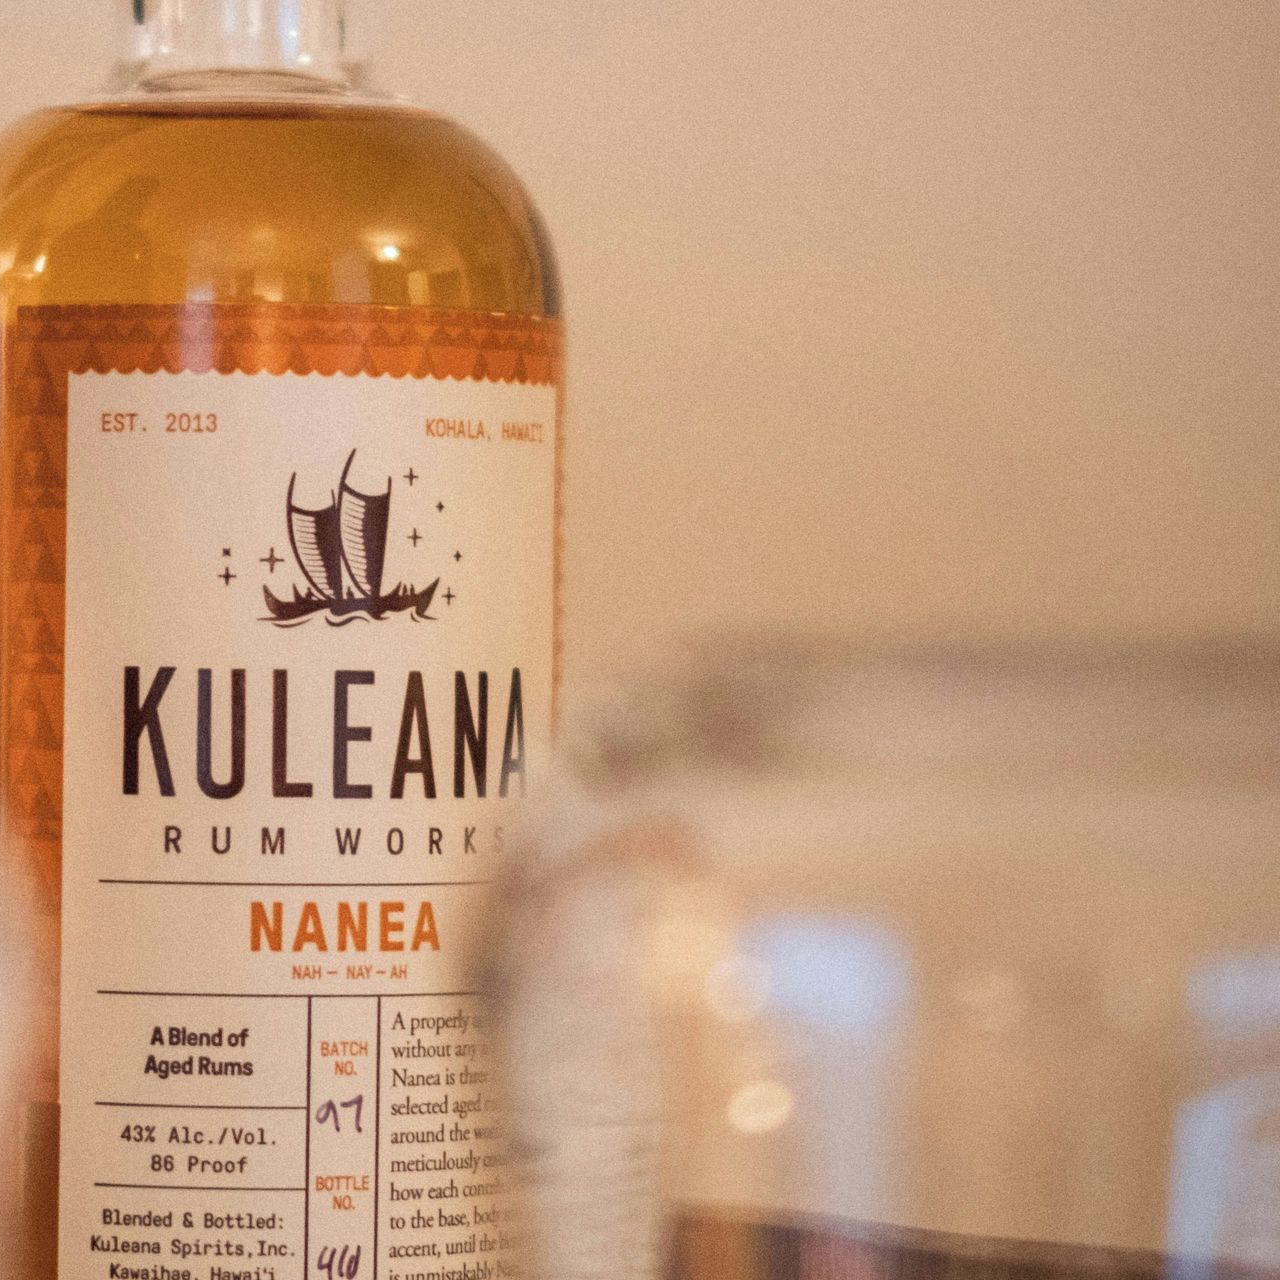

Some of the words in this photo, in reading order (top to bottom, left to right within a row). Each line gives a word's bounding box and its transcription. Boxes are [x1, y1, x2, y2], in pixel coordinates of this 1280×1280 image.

[101, 413, 148, 433] EST.
[166, 413, 218, 433] 2013
[122, 666, 528, 799] KULEANA
[164, 826, 286, 855] RUM
[250, 901, 440, 952] NANEA
[292, 965, 322, 979] NAH
[346, 965, 372, 979] NAY
[390, 964, 408, 979] AH
[392, 1010, 406, 1030] A
[410, 1009, 469, 1035] properly
[150, 1026, 164, 1046] A
[168, 1026, 223, 1046] Blend
[227, 1028, 249, 1047] of
[320, 1041, 368, 1057] BATCH
[391, 1039, 451, 1058] without
[144, 1054, 194, 1080] Aged
[198, 1056, 254, 1076] Rums
[334, 1060, 357, 1076] NO.
[391, 1068, 441, 1087] Nanea
[445, 1068, 456, 1085] is
[391, 1094, 449, 1116] selected
[452, 1093, 481, 1119] aged
[120, 1125, 156, 1143] 43%
[168, 1126, 277, 1145] Alc./Vol.
[390, 1123, 445, 1144] around
[449, 1122, 470, 1141] the
[151, 1155, 174, 1172] 86
[188, 1156, 248, 1173] Proof
[390, 1149, 481, 1174] meticulously
[315, 1175, 369, 1191] BOTTLE
[390, 1182, 424, 1201] how
[427, 1179, 459, 1199] each
[332, 1195, 355, 1210] NO.
[102, 1208, 173, 1228] Blended
[182, 1212, 194, 1228] &
[204, 1212, 284, 1230] Bottled:
[389, 1216, 406, 1230] to
[410, 1209, 434, 1229] the
[438, 1208, 470, 1228] base,
[90, 1235, 161, 1254] Kuleana
[389, 1243, 441, 1258] accent,
[445, 1233, 476, 1255] until
